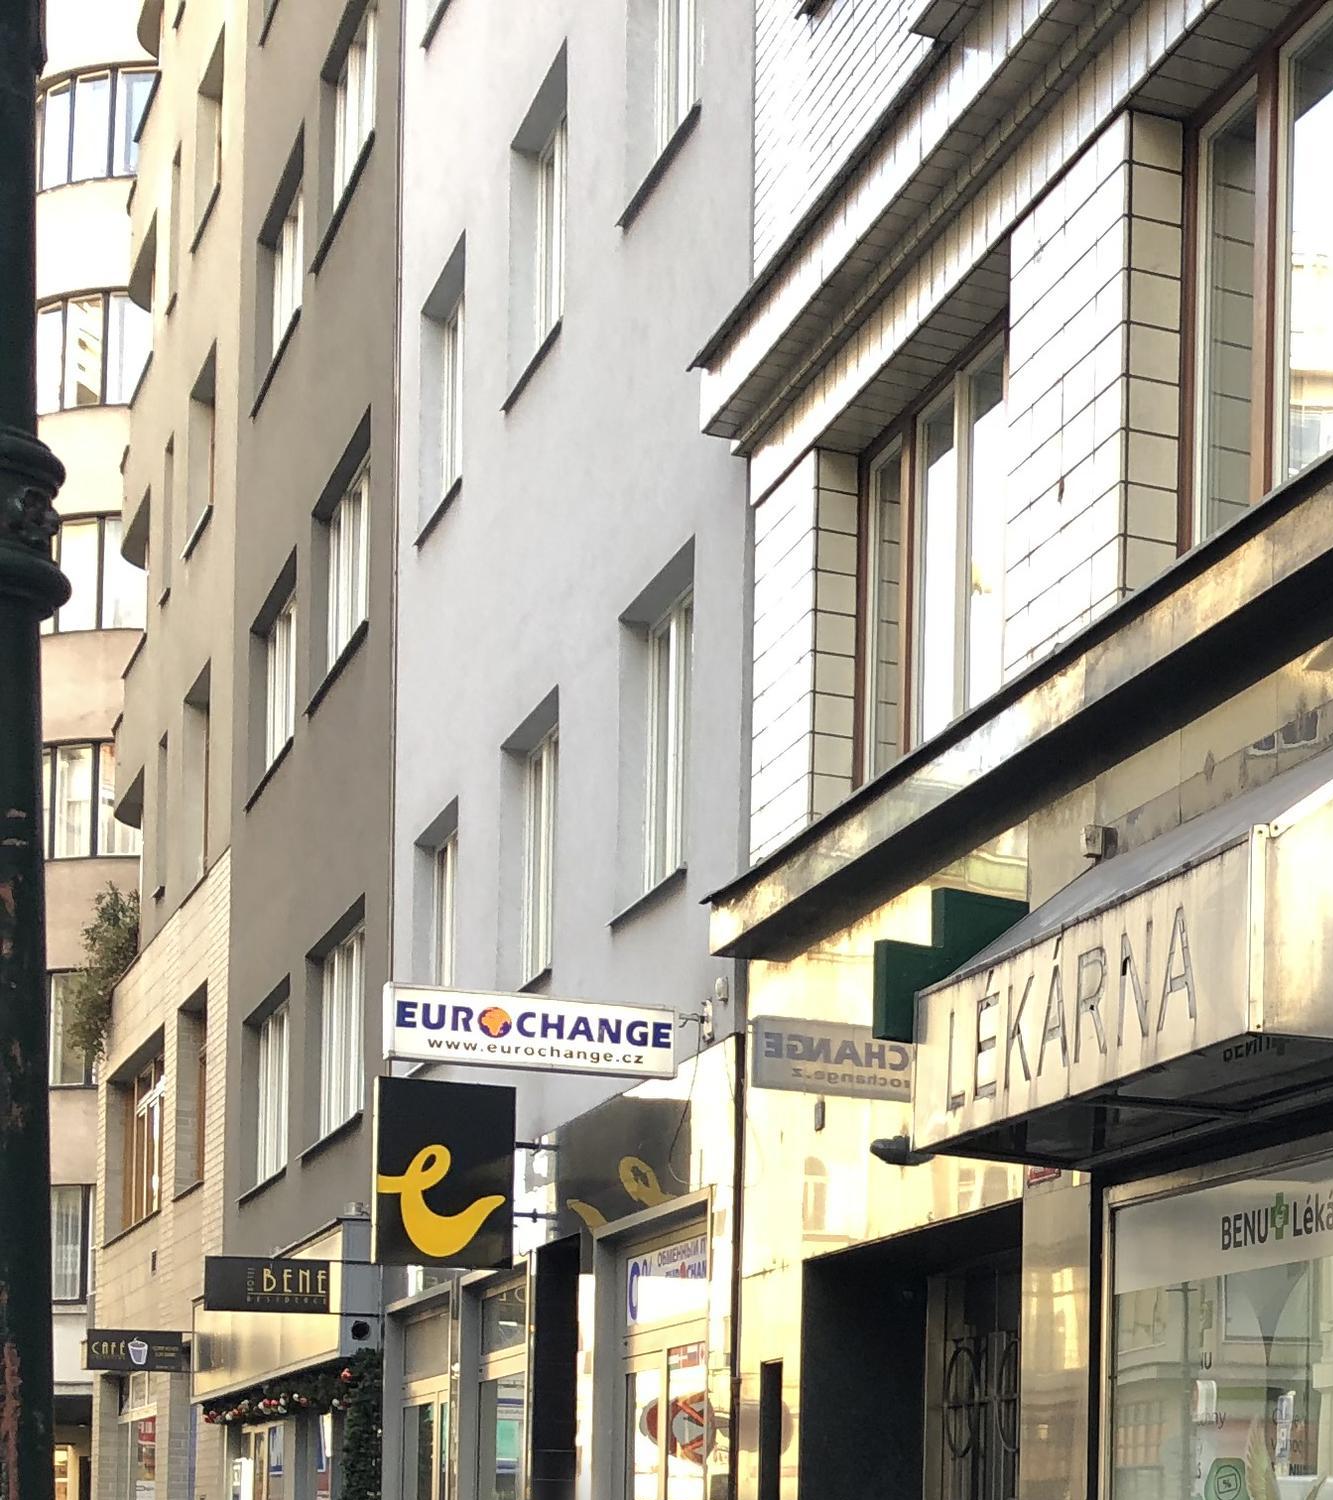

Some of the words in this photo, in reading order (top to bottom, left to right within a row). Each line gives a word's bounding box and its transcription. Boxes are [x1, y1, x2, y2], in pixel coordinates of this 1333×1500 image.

[944, 902, 1199, 1113] LÉKÁRNA
[427, 1037, 644, 1063] www.eurochange.cz
[1221, 1207, 1269, 1250] BENU
[263, 1268, 327, 1293] BENE
